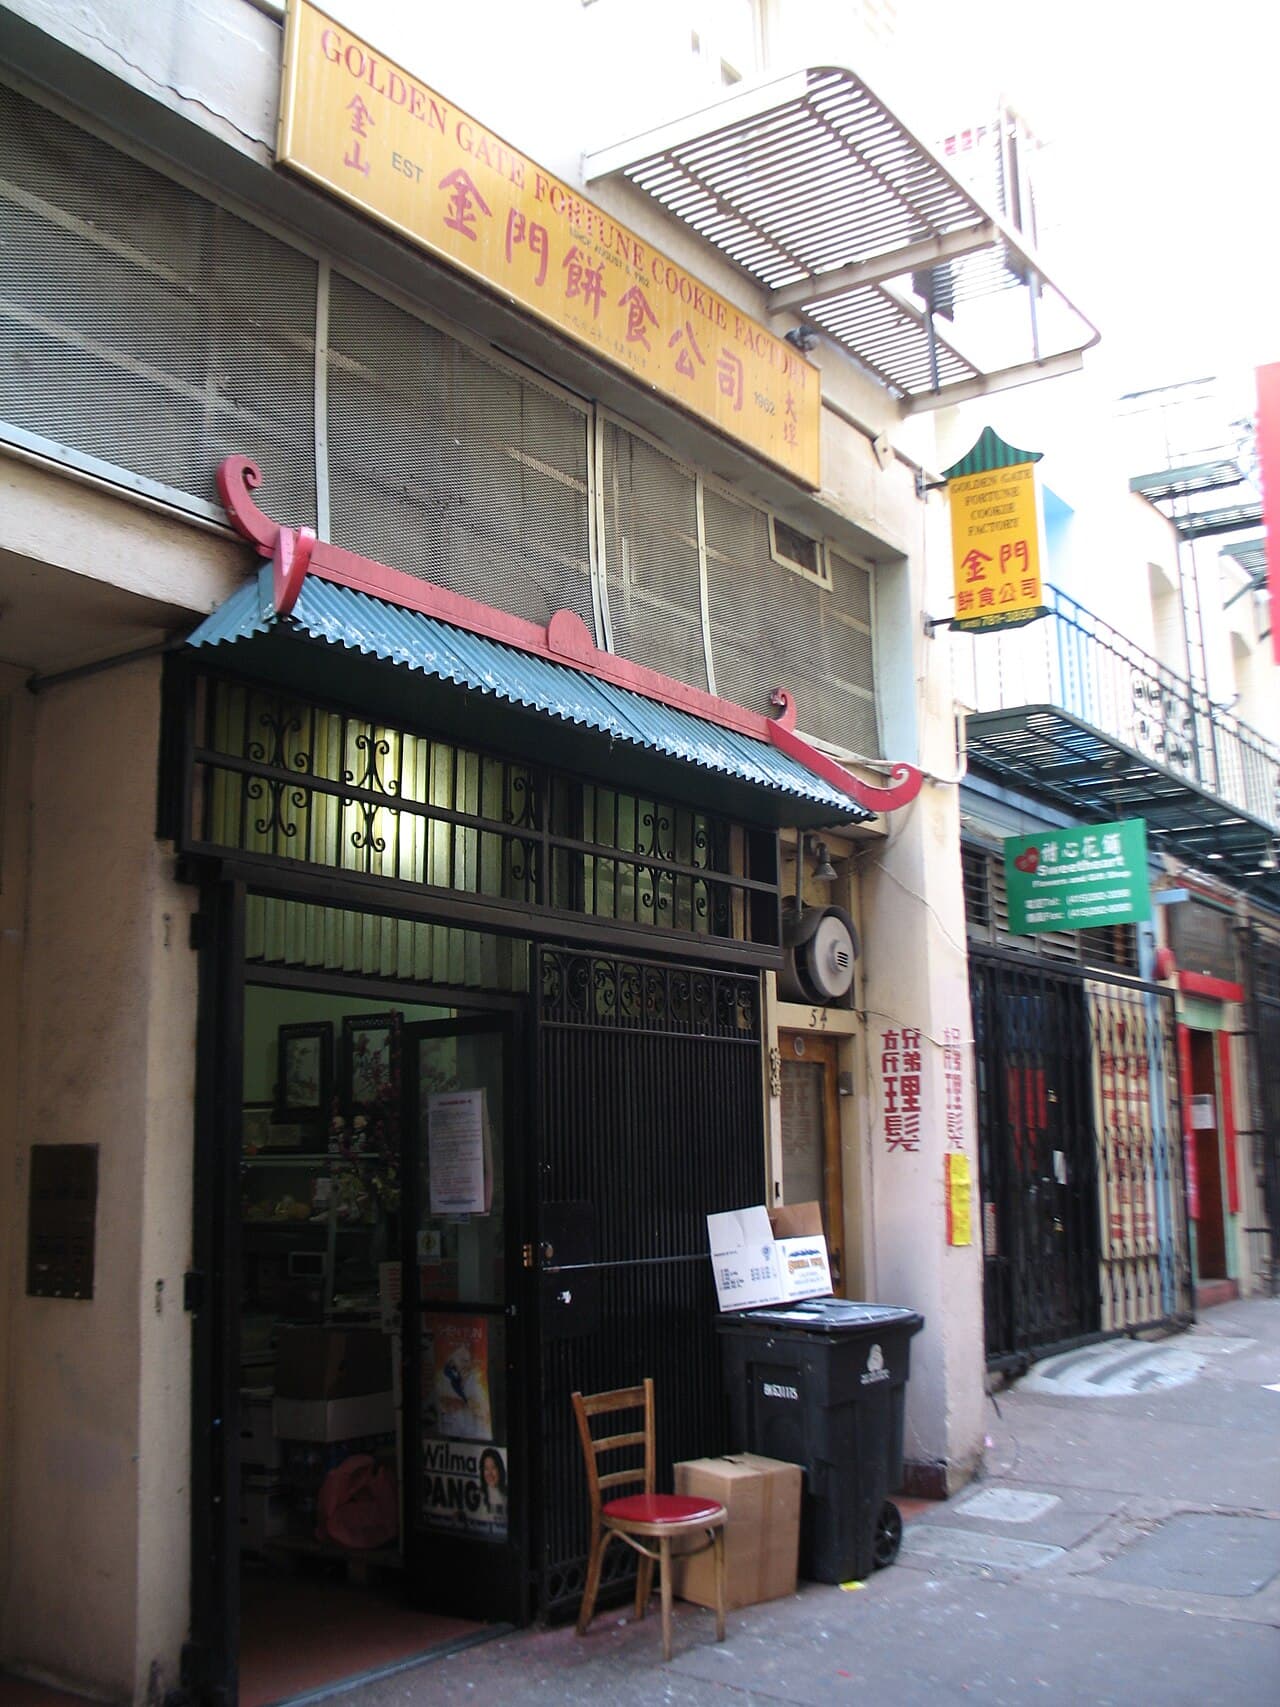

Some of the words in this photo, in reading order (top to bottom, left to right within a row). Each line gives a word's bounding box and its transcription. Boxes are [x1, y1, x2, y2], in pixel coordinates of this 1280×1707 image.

[344, 93, 376, 179] 金山
[321, 29, 448, 135] GOLDEN
[456, 121, 525, 190] GATE
[534, 172, 645, 272] FORTUNE
[652, 256, 728, 331] COOKIE
[391, 151, 424, 184] EST
[950, 475, 998, 494] GOLDEN
[1000, 469, 1033, 483] GATE
[964, 486, 1020, 506] FORTUNE
[970, 502, 1016, 520] COOKIE
[967, 517, 1020, 537] FACTORY
[960, 540, 1029, 583] 金門
